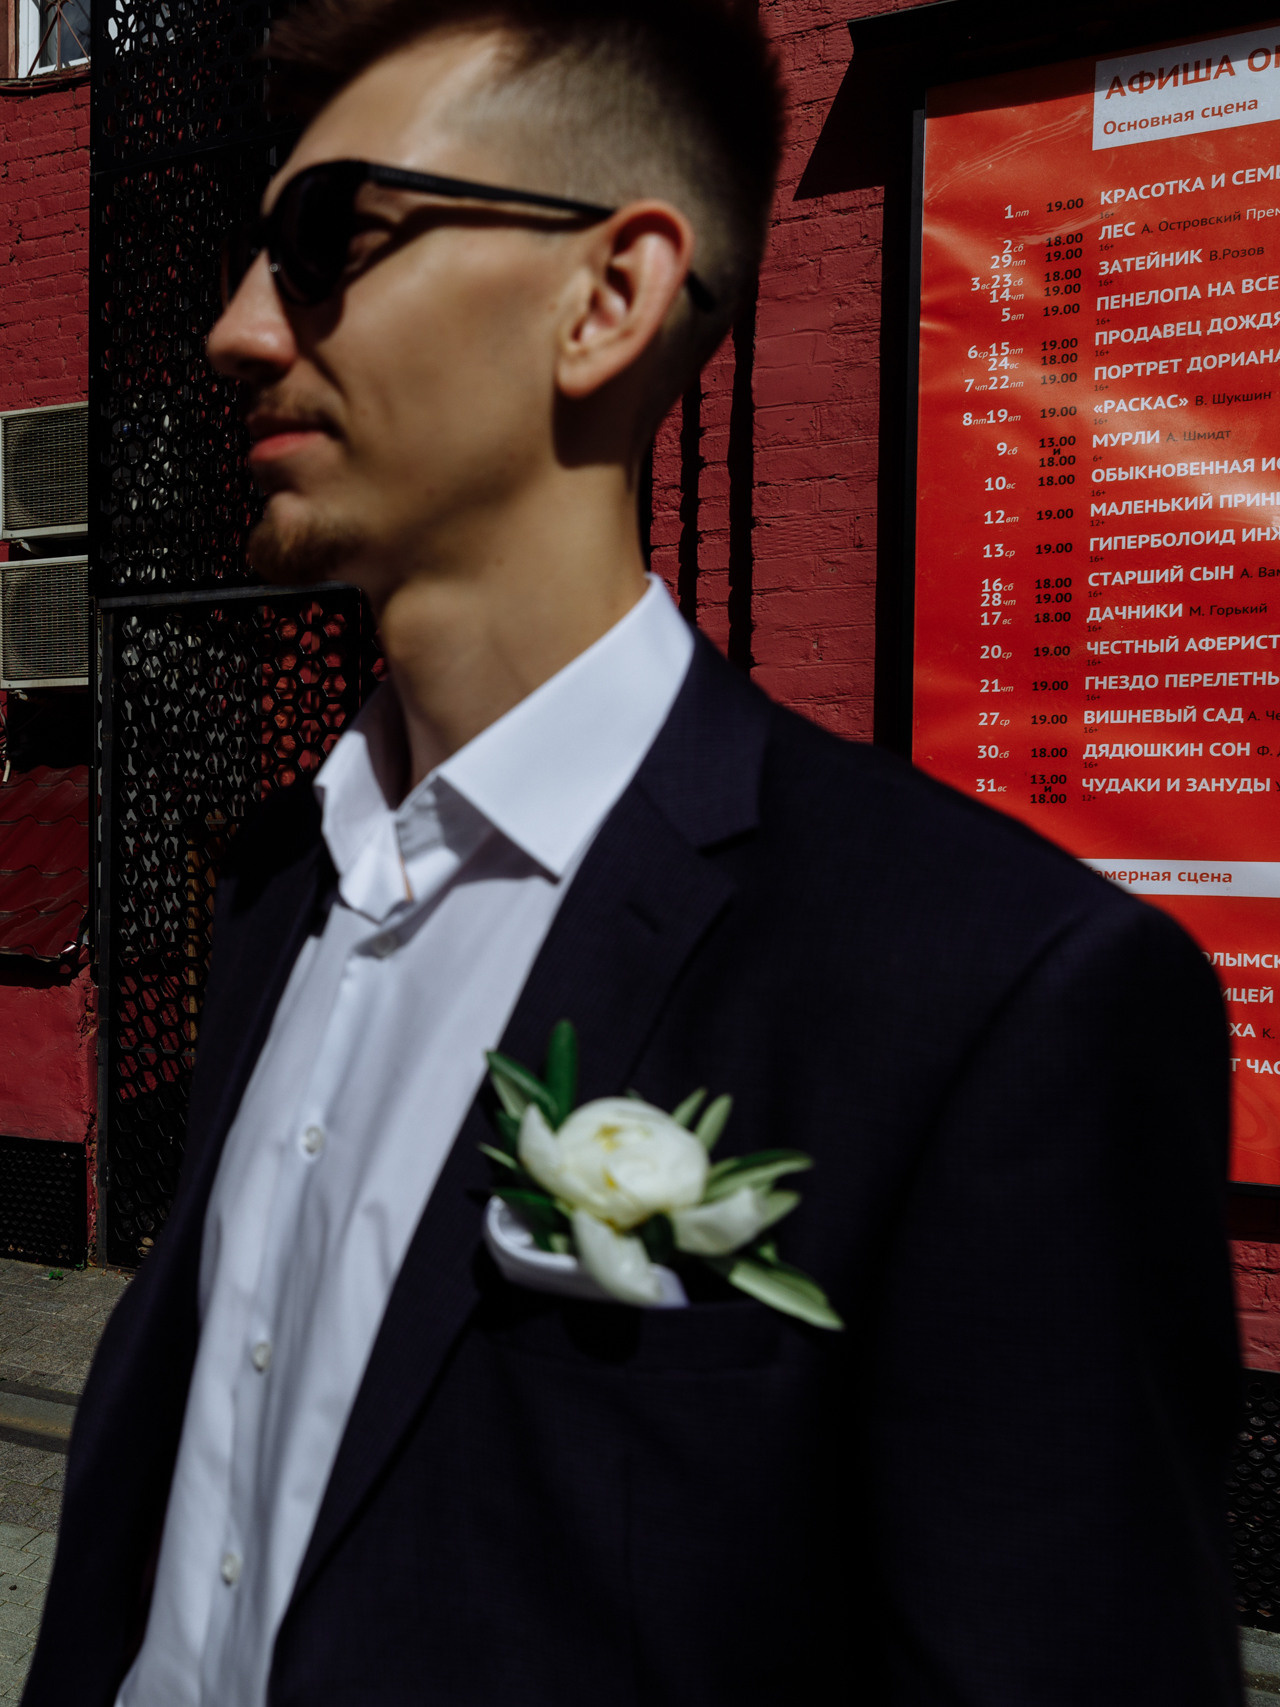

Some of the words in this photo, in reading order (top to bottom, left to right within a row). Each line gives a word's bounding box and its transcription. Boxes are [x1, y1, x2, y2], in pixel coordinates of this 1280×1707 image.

[1105, 54, 1237, 100] АФИША
[1247, 44, 1280, 73] О
[1103, 109, 1195, 135] Основная
[1201, 98, 1259, 118] сцена
[1100, 176, 1205, 205] КРАСОТКА
[1211, 173, 1226, 189] И
[1046, 197, 1084, 213] 19.00
[1100, 212, 1115, 220] 16+
[1098, 221, 1136, 241] ЛЕС
[1141, 223, 1153, 234] А.
[1158, 210, 1241, 231] Островский
[1045, 232, 1083, 247] 18.00
[1099, 243, 1114, 251] 16+
[1045, 247, 1083, 262] 19.00
[1098, 249, 1203, 276] ЗАТЕЙНИК
[1044, 267, 1082, 282] 18.00
[1098, 279, 1113, 287] 16+
[1043, 283, 1081, 297] 19.00
[1096, 284, 1202, 311] ПЕНЕЛОПА
[1207, 281, 1236, 298] НА
[1042, 303, 1080, 317] 19.00
[1095, 318, 1111, 326] 16+
[1095, 320, 1202, 346] ПРОДАВЕЦ
[1041, 337, 1078, 351] 19.00
[1040, 352, 1078, 366] 18.00
[1095, 349, 1110, 357] 16+
[1094, 358, 1182, 381] ПОРТРЕТ
[1040, 372, 1078, 385] 19.00
[1094, 384, 1109, 392] 16+
[1093, 394, 1189, 414] «РАСКАС»
[1195, 395, 1207, 406] В.
[1212, 391, 1272, 405] Шукшин
[1040, 405, 1077, 419] 19.00
[1039, 435, 1076, 448] 13.00
[1092, 430, 1160, 448] МУРЛИ
[1166, 432, 1179, 443] А.
[1183, 429, 1232, 442] Шмидт
[1053, 448, 1061, 456] и
[1039, 455, 1076, 468] 18.00
[1091, 458, 1255, 483] ОБЫКНОВЕННАЯ
[1038, 474, 1075, 487] 18.00
[1090, 489, 1106, 497] 16+
[1090, 493, 1213, 518] МАЛЕНЬКИЙ
[1036, 508, 1074, 521] 19.00
[1089, 519, 1105, 527] 12+
[1089, 529, 1236, 552] ГИПЕРБОЛОИД
[1035, 542, 1073, 555] 19.00
[1089, 555, 1104, 563] 16+
[1087, 565, 1184, 587] СТАРШИЙ
[1189, 565, 1234, 582] СЫН
[1240, 568, 1253, 579] А.
[1035, 577, 1072, 589] 18.00
[1035, 592, 1072, 604] 19.00
[1087, 590, 1103, 598] 16+
[1034, 611, 1071, 624] 18.00
[1086, 603, 1183, 623] ДАЧНИКИ
[1189, 606, 1205, 617] М.
[1210, 603, 1268, 618] Горький
[1087, 625, 1102, 633] 16+
[1033, 645, 1071, 657] 19.00
[1086, 635, 1179, 655] ЧЕСТНЫЙ
[1184, 634, 1280, 652] АФЕРИСТ
[1086, 659, 1102, 667] 16+
[1032, 680, 1069, 691] 19.00
[1085, 674, 1159, 691] ГНЕЗДО
[1086, 693, 1101, 701] 16+
[1031, 714, 1068, 725] 19.00
[1083, 705, 1197, 724] ВИШНЕВЫЙ
[1202, 707, 1244, 724] САД
[1247, 710, 1260, 721] А.
[1083, 726, 1099, 734] 16+
[1031, 747, 1068, 758] 18.00
[1082, 742, 1203, 759] ДЯДЮШКИН
[1209, 742, 1251, 757] СОН
[1257, 745, 1273, 756] Ф.
[1083, 761, 1098, 769] 16+
[1030, 774, 1067, 785] 13.00
[1082, 777, 1160, 794] ЧУДАКИ
[1166, 777, 1180, 792] И
[1185, 777, 1271, 794] ЗАНУДЫ
[1044, 785, 1052, 793] и
[1030, 793, 1067, 804] 18.00
[1090, 867, 1172, 885] мерная
[1177, 871, 1233, 883] сцена
